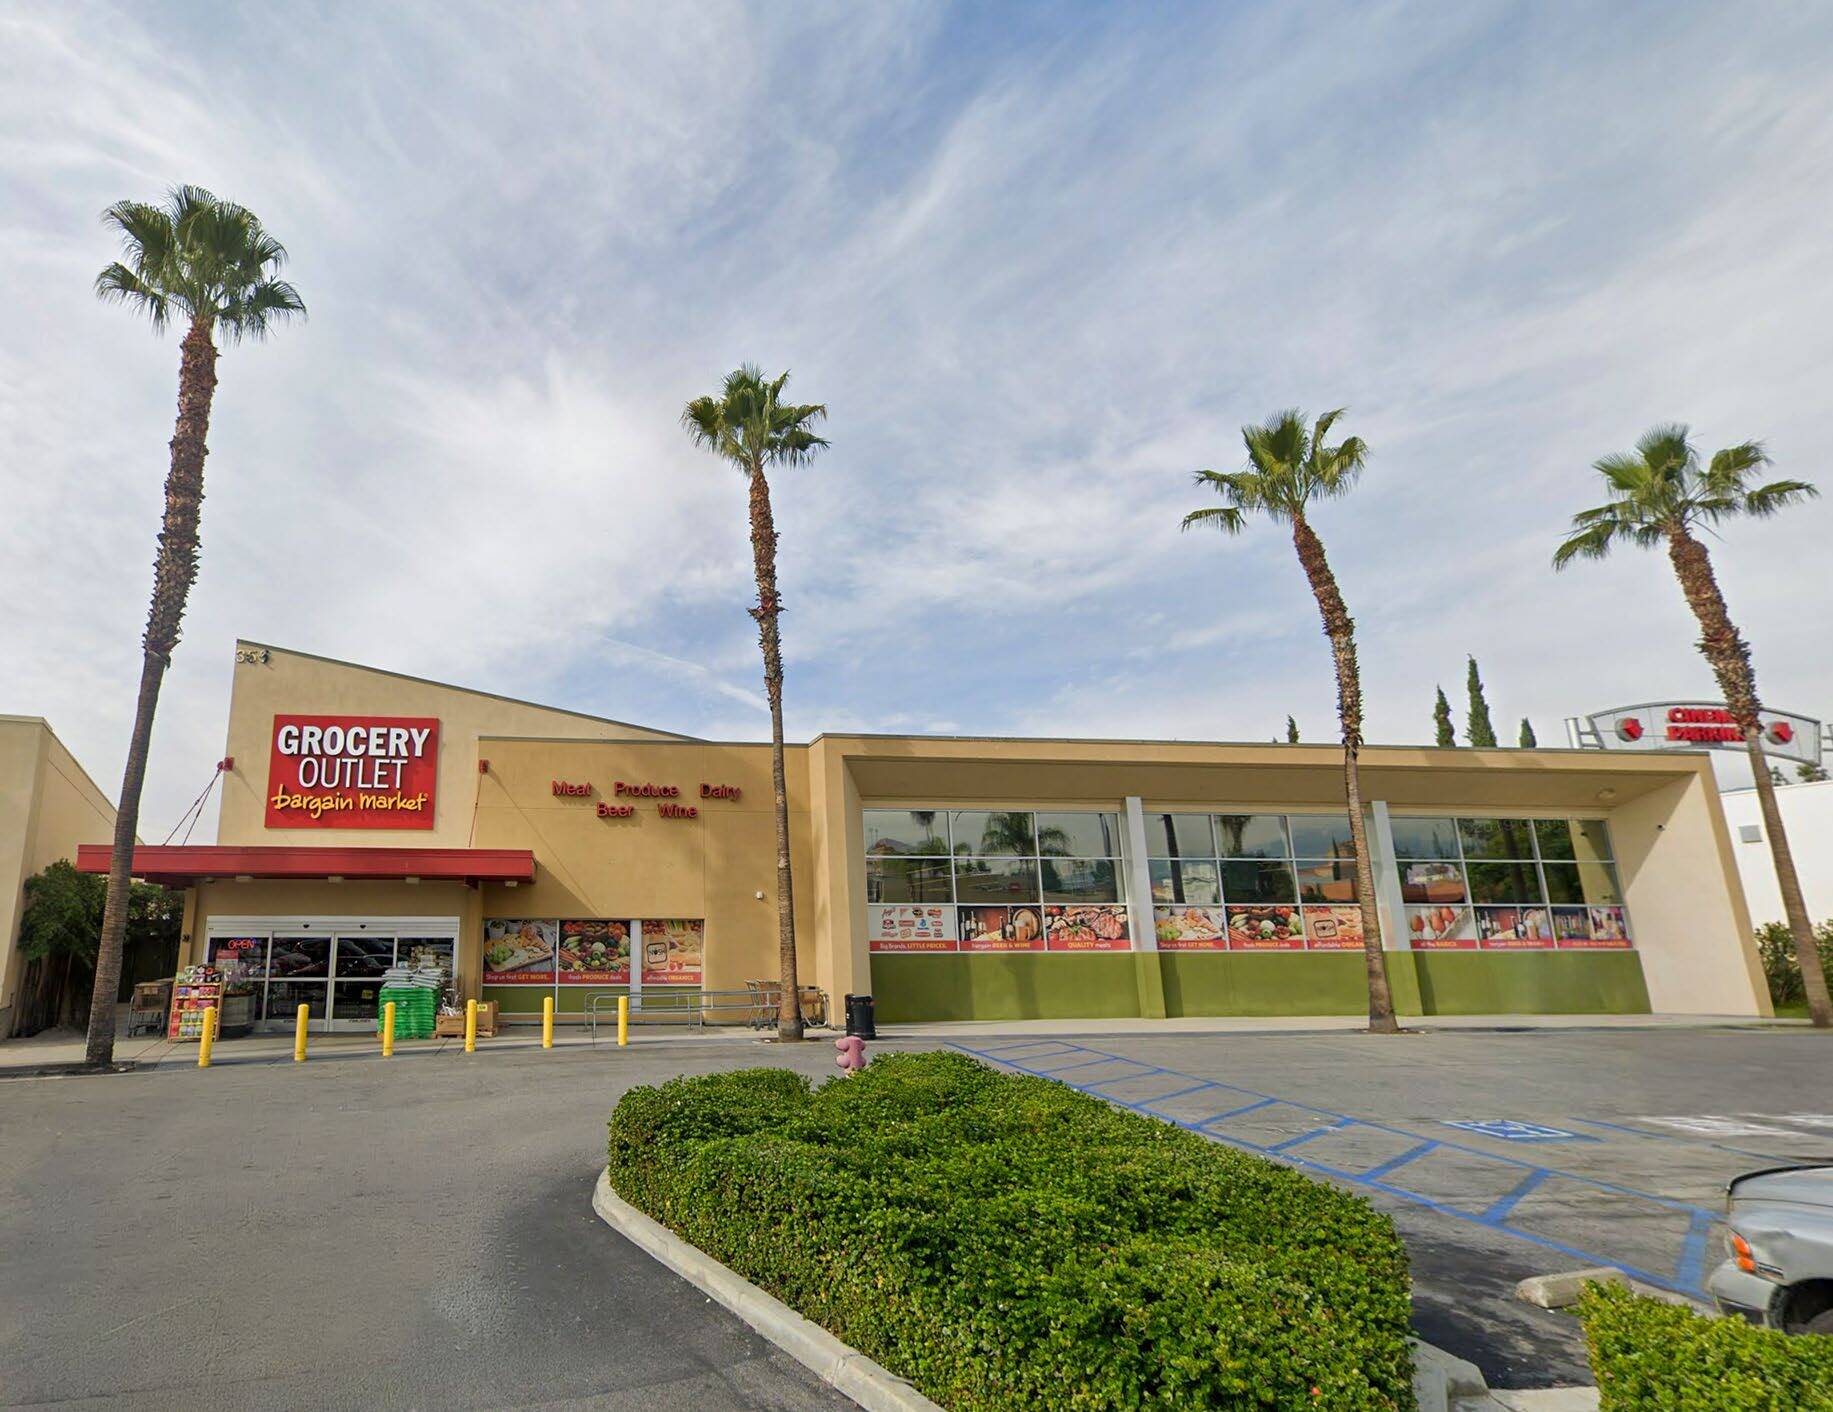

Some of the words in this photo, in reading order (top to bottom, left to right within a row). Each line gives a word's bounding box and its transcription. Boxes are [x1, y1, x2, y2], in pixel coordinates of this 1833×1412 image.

[277, 725, 431, 757] GROCERY
[298, 757, 408, 789] OUTLET
[552, 780, 592, 796] Meat
[614, 781, 680, 797] Produce
[700, 783, 743, 801] Dairy
[271, 784, 353, 819] bargain
[359, 792, 426, 811] market
[596, 801, 635, 818] Beer
[657, 803, 698, 819] Wine
[228, 938, 256, 950] OPEN
[1067, 941, 1094, 949] QUALITY
